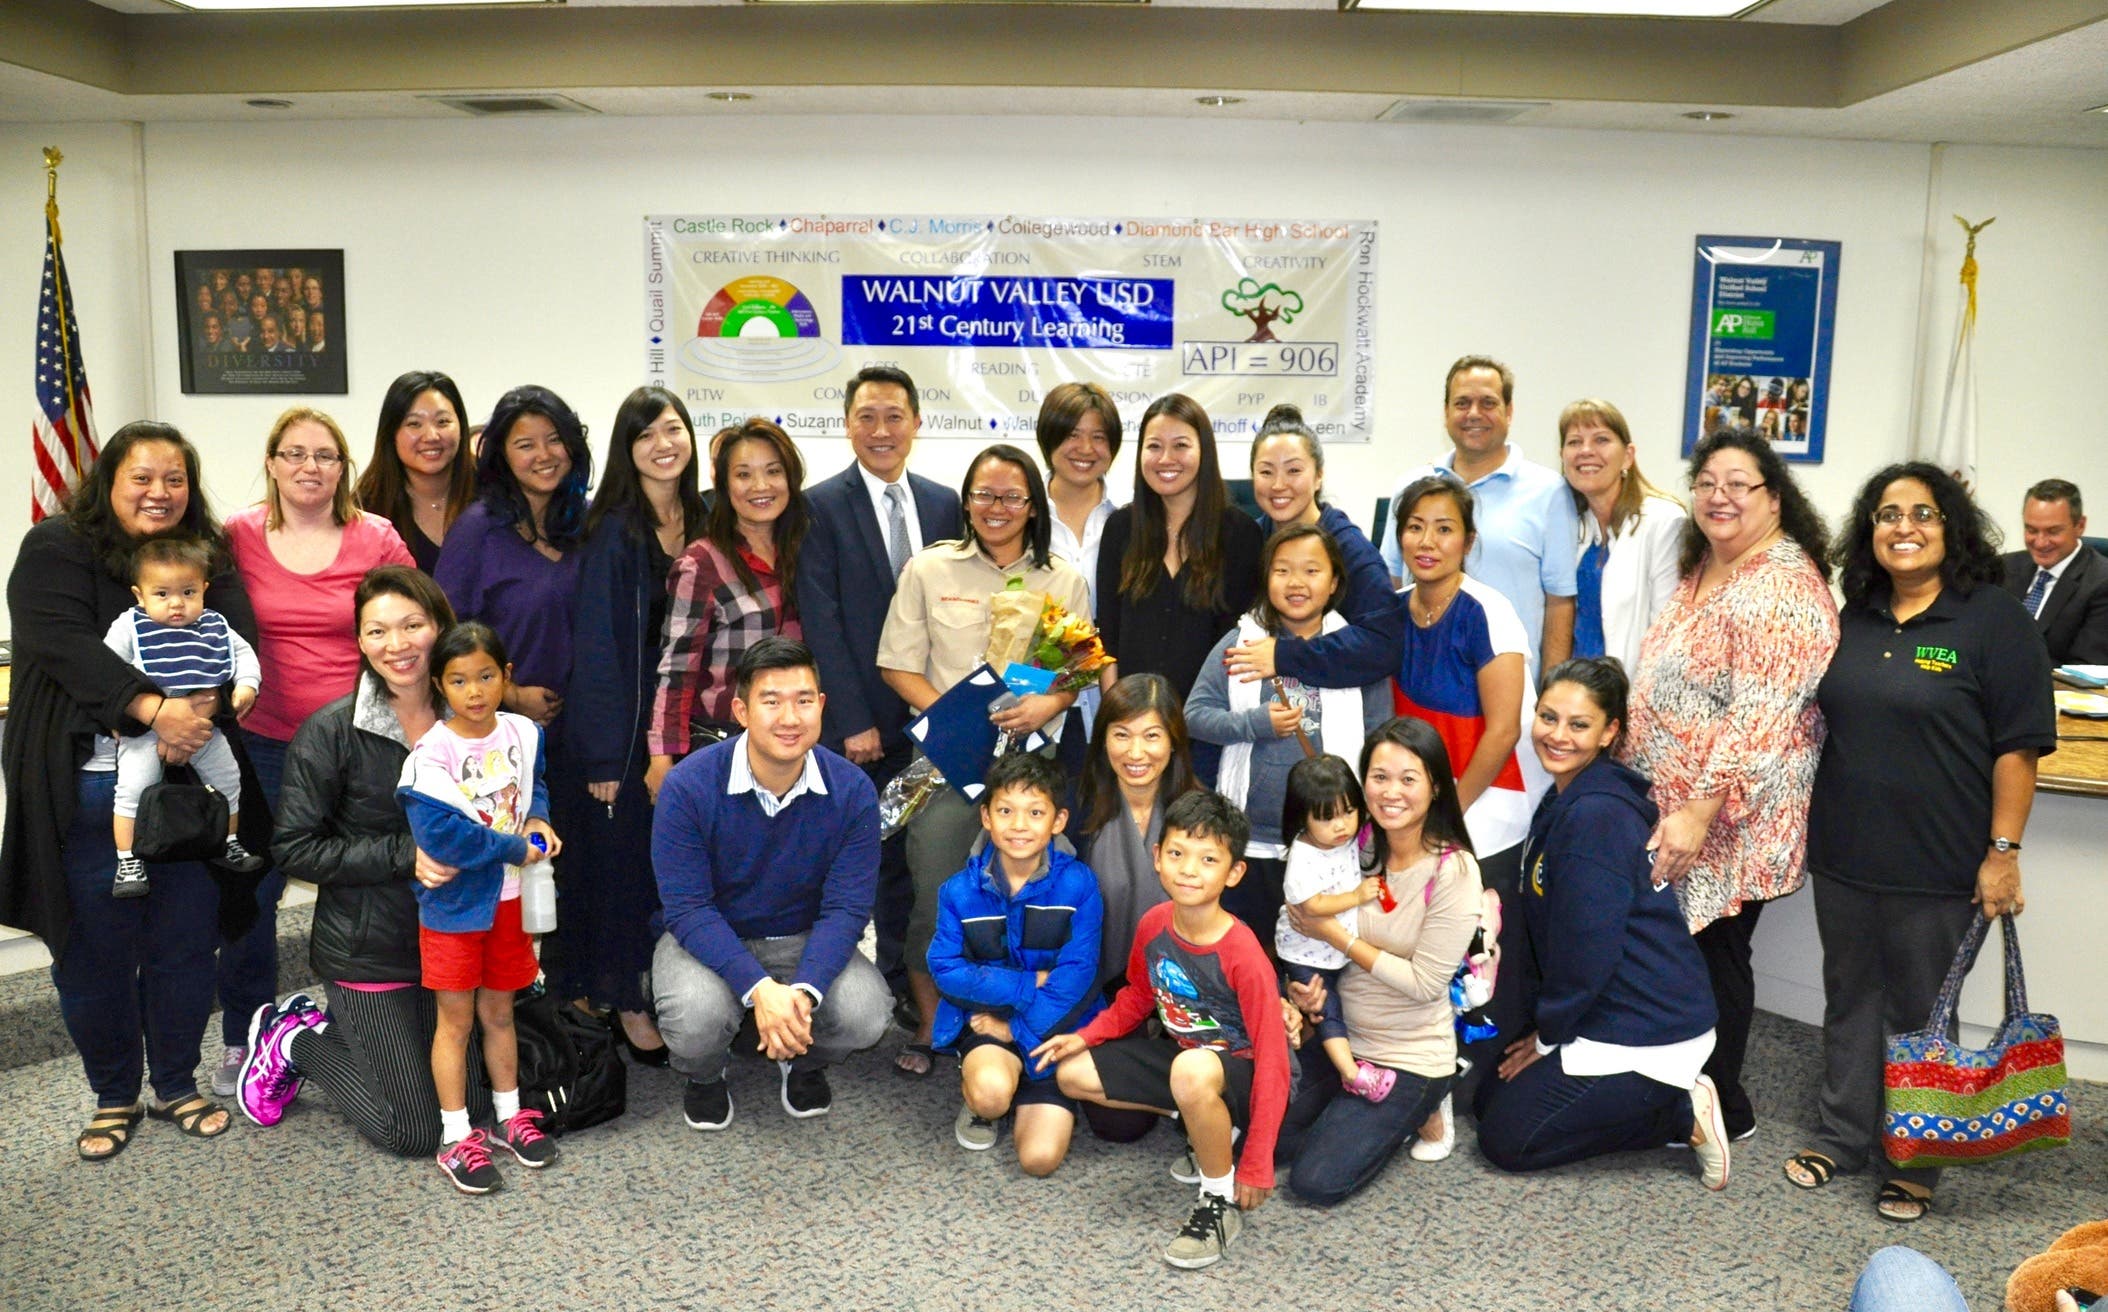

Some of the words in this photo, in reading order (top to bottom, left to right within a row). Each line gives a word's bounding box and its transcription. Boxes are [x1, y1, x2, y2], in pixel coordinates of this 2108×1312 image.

[673, 218, 726, 234] Castle
[732, 218, 773, 233] Rock
[791, 218, 873, 236] Chaparral
[929, 219, 982, 234] Morris
[999, 219, 1110, 238] Collegewood
[1127, 220, 1202, 238] Diamond
[1210, 222, 1240, 238] Bar
[1290, 223, 1350, 239] School
[649, 221, 663, 283] Summit
[693, 250, 761, 264] CREATIVE
[767, 250, 840, 264] THINKING
[1359, 231, 1375, 265] Ron
[1143, 254, 1182, 267] STEM
[1243, 256, 1328, 269] CREATIVITY
[861, 279, 984, 304] WALNUT
[990, 280, 1088, 305] VALLEY
[1095, 282, 1155, 307] USD
[649, 290, 664, 332] Quail
[1356, 271, 1373, 348] Hockwalt
[892, 314, 934, 336] 21st
[939, 315, 1025, 343] Century
[1031, 316, 1125, 344] Learning
[1714, 313, 1743, 333] AP
[207, 354, 320, 369] DIVERSITY
[650, 348, 664, 373] Hill
[1186, 346, 1236, 371] API
[1249, 356, 1268, 367] =
[1280, 347, 1335, 372] 906
[687, 388, 725, 401] PLTW
[1238, 393, 1265, 406] PYP
[1313, 394, 1328, 406] IB
[1352, 353, 1371, 431] Academy
[693, 412, 716, 427] uth
[786, 413, 846, 428] Suzann
[927, 415, 983, 430] Walnut
[1916, 646, 1957, 664] WVEA
